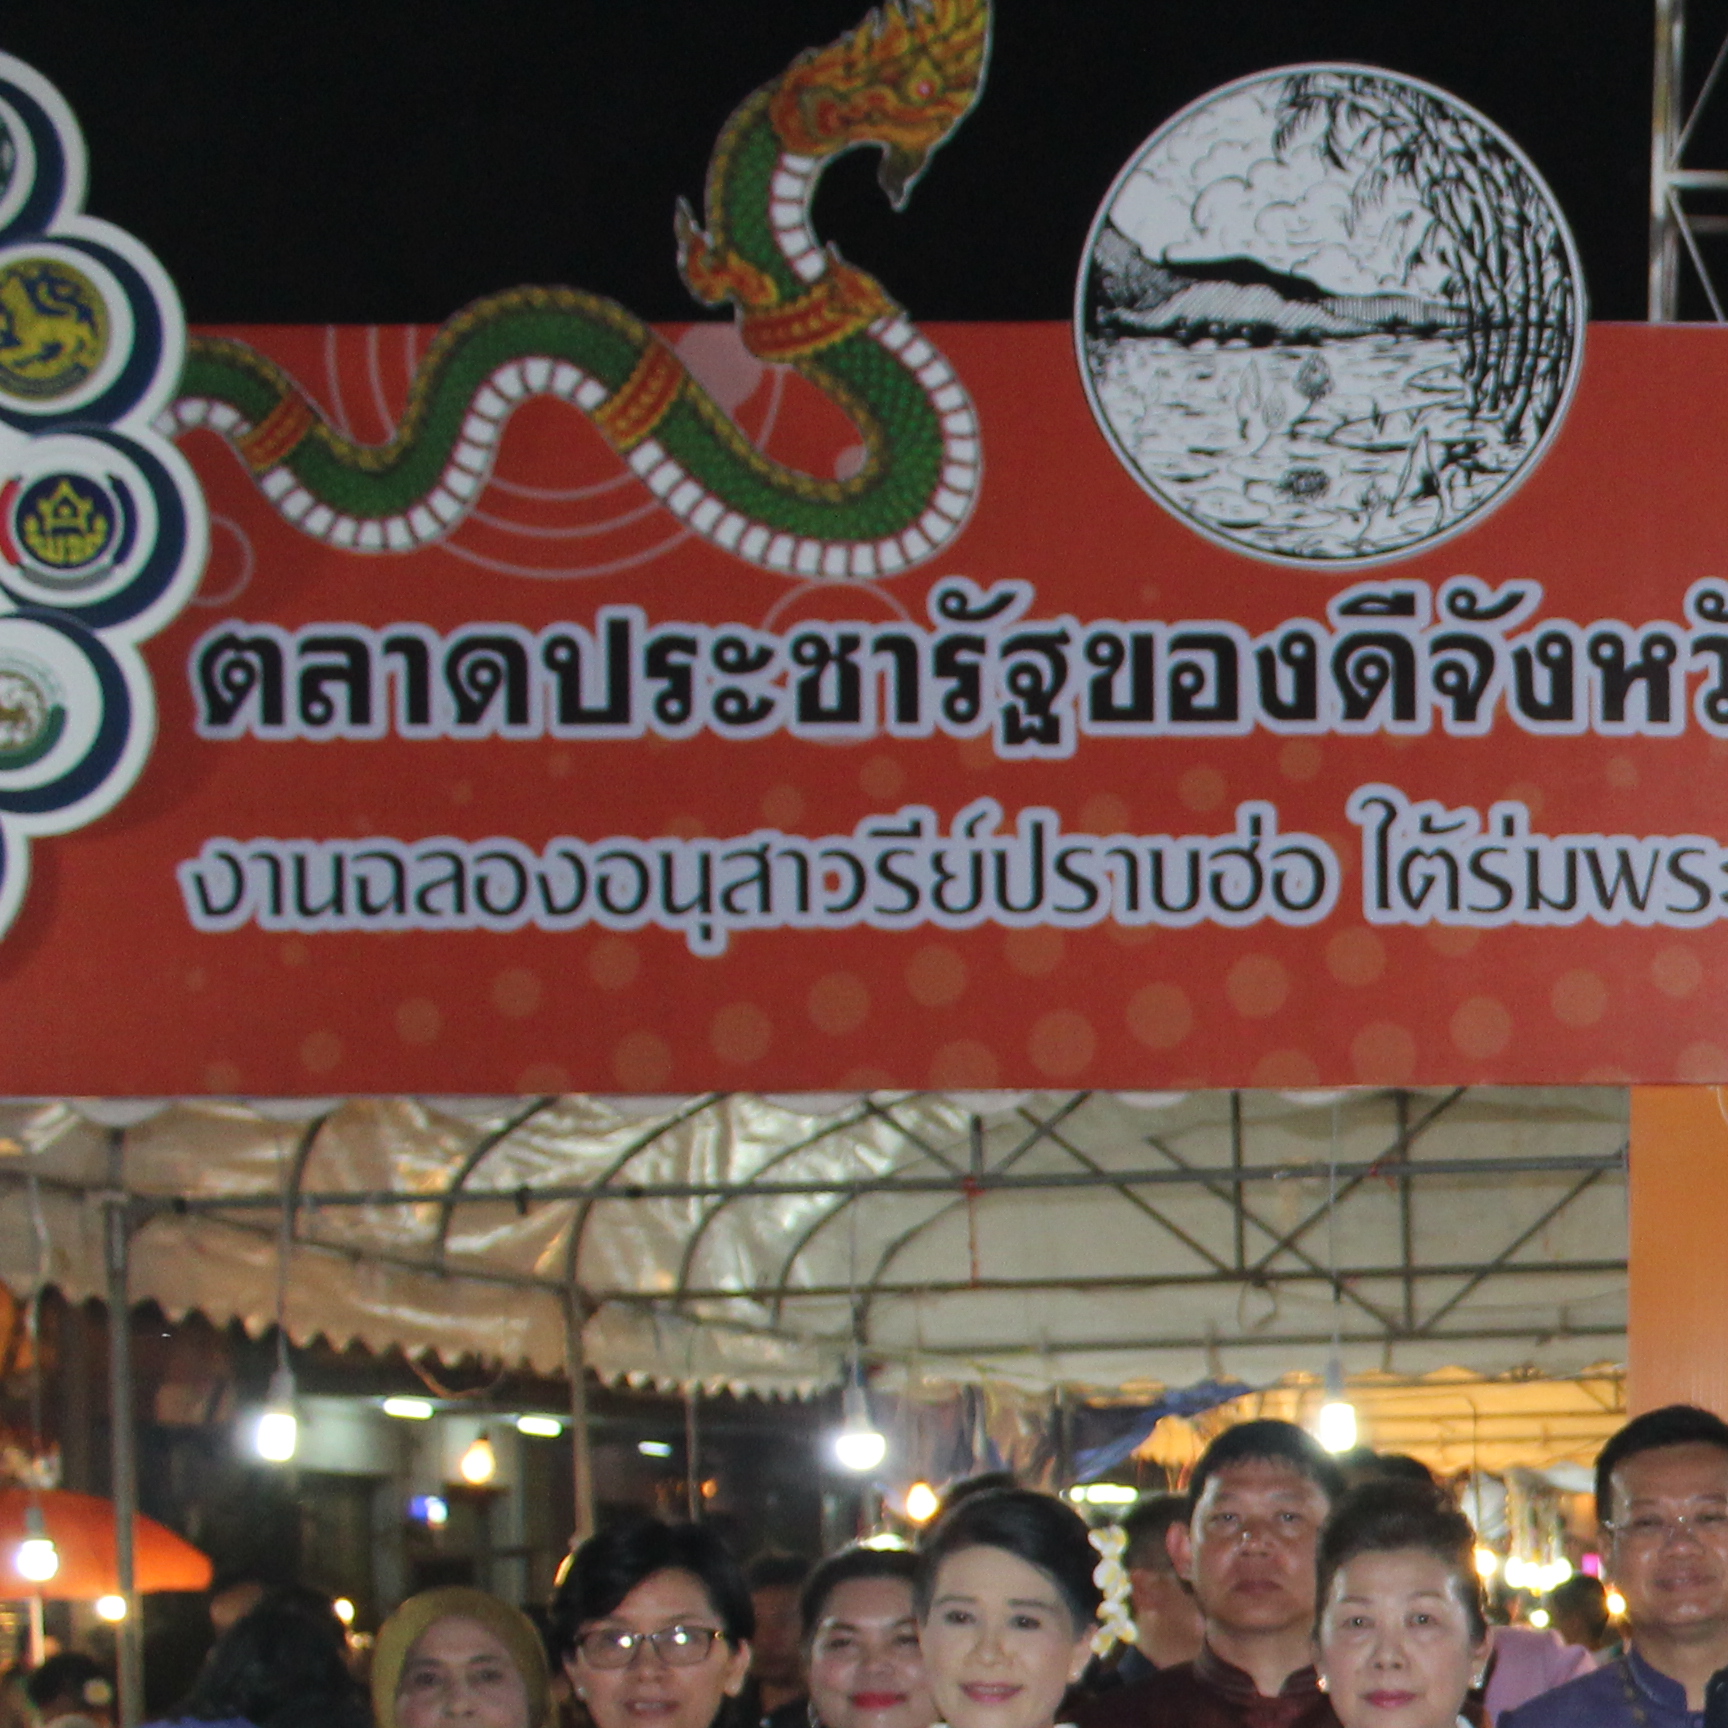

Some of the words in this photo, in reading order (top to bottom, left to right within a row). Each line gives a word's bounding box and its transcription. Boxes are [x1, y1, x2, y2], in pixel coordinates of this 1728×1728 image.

[194, 800, 1328, 942] งานฉลองอนุสาวรีย์ปราบฮ่อ
